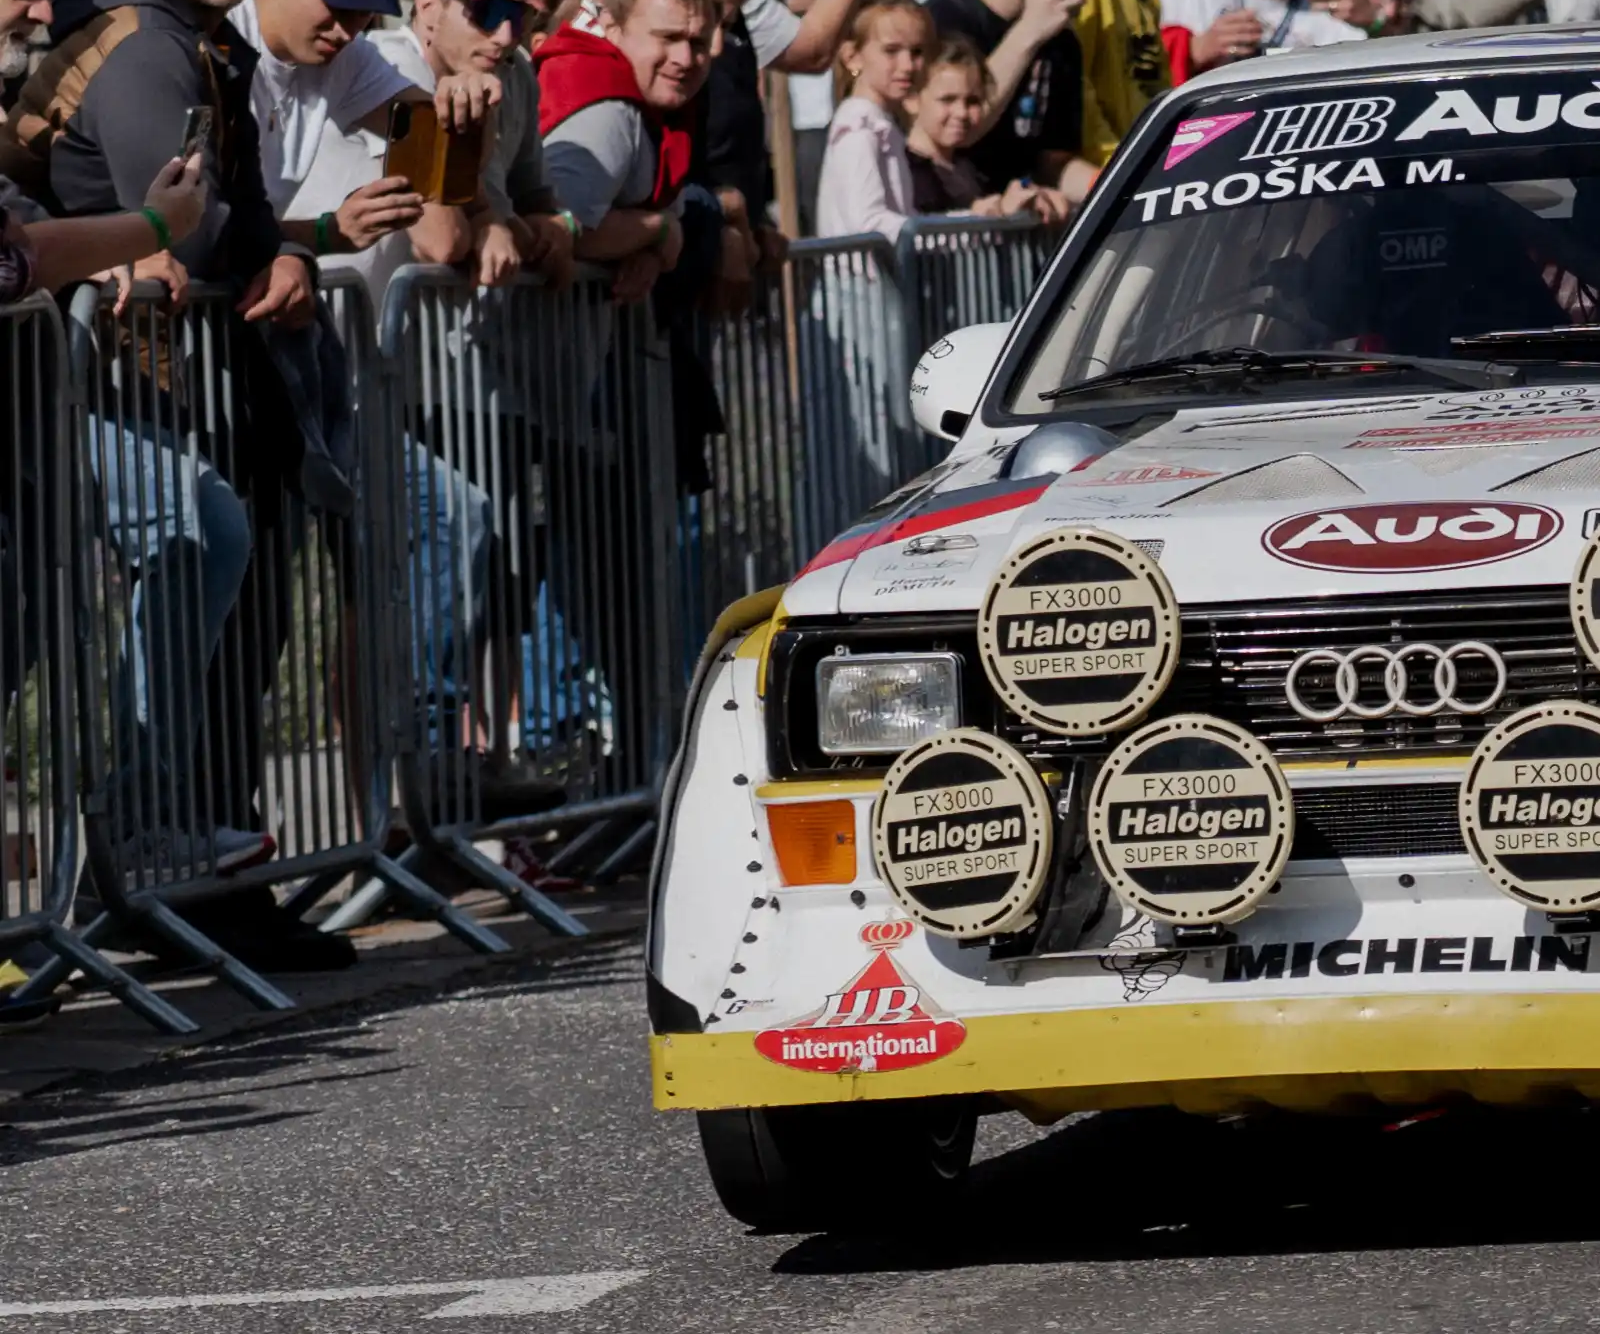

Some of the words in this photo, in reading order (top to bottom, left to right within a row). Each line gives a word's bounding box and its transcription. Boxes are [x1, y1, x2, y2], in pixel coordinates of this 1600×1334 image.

[1239, 96, 1397, 162] HB
[1133, 156, 1386, 223] TROŠKA
[1405, 158, 1467, 185] M.
[1379, 233, 1449, 264] OMP
[1278, 507, 1542, 550] Audi
[1030, 585, 1122, 610] FX3000
[1007, 617, 1151, 650] Halogen
[1013, 656, 1076, 676] SUPER
[1082, 652, 1146, 672] SPORT
[913, 785, 994, 816] FX3000
[1143, 774, 1237, 798] FX3000
[896, 816, 1022, 857] Halogen
[1117, 804, 1266, 839] Halogen
[1124, 844, 1189, 864] SUPER
[1194, 841, 1259, 860] SPORT
[1494, 832, 1560, 850] SUPER
[904, 859, 960, 882] SUPER
[963, 851, 1019, 874] SPORT
[1222, 935, 1591, 983] MICHELIN
[811, 984, 921, 1029] HB
[781, 1029, 937, 1061] international
